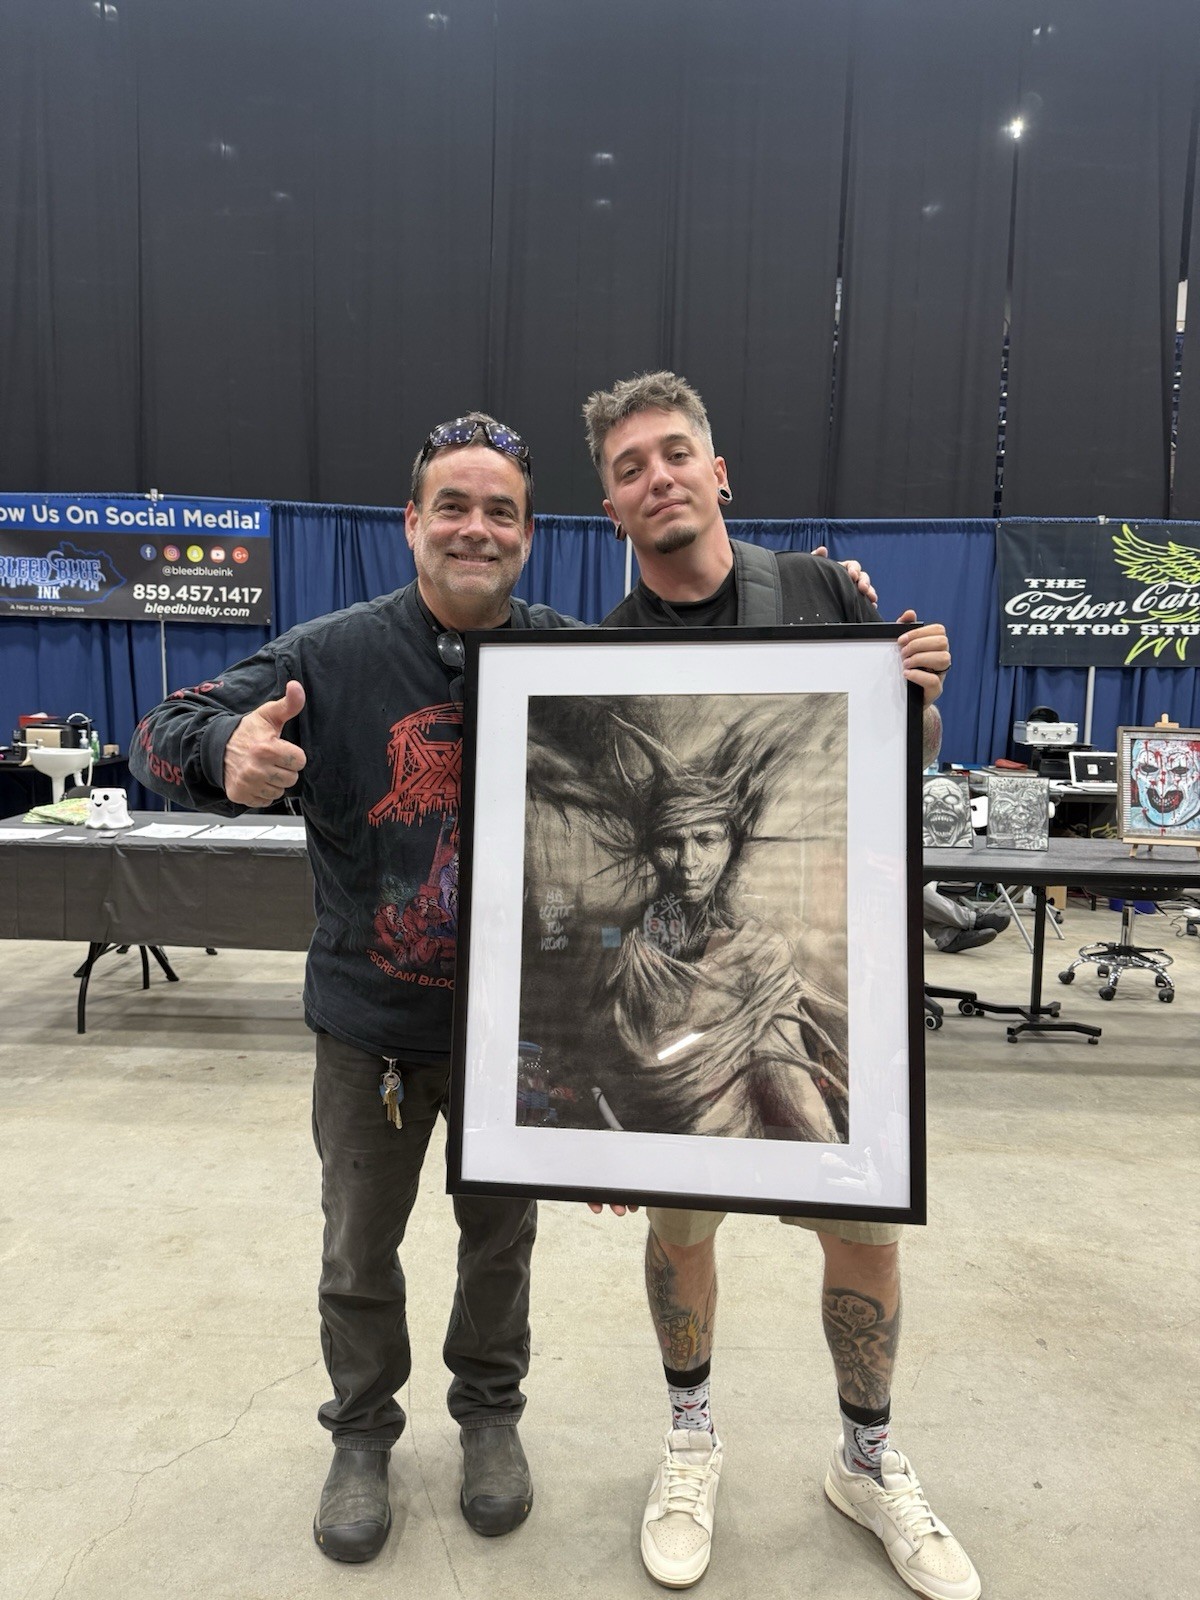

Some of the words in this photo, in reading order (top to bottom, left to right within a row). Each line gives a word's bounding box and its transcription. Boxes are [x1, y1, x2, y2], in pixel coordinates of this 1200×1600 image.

[31, 504, 60, 524] Us
[66, 505, 99, 525] On
[105, 506, 176, 527] Social
[183, 508, 260, 530] Media!
[0, 556, 52, 584] BLEED
[54, 557, 102, 585] BLUE
[162, 565, 234, 577] @bleedblueink
[1024, 578, 1087, 589] THE
[37, 586, 60, 600] INK
[132, 583, 263, 604] 859.457.1417
[49, 605, 66, 613] Tattoo
[67, 605, 85, 613] Shops
[144, 602, 250, 618] bleedblueky.com
[1004, 591, 1128, 621] Carbon
[1007, 624, 1130, 636] TATTOO
[1140, 624, 1200, 636] STU
